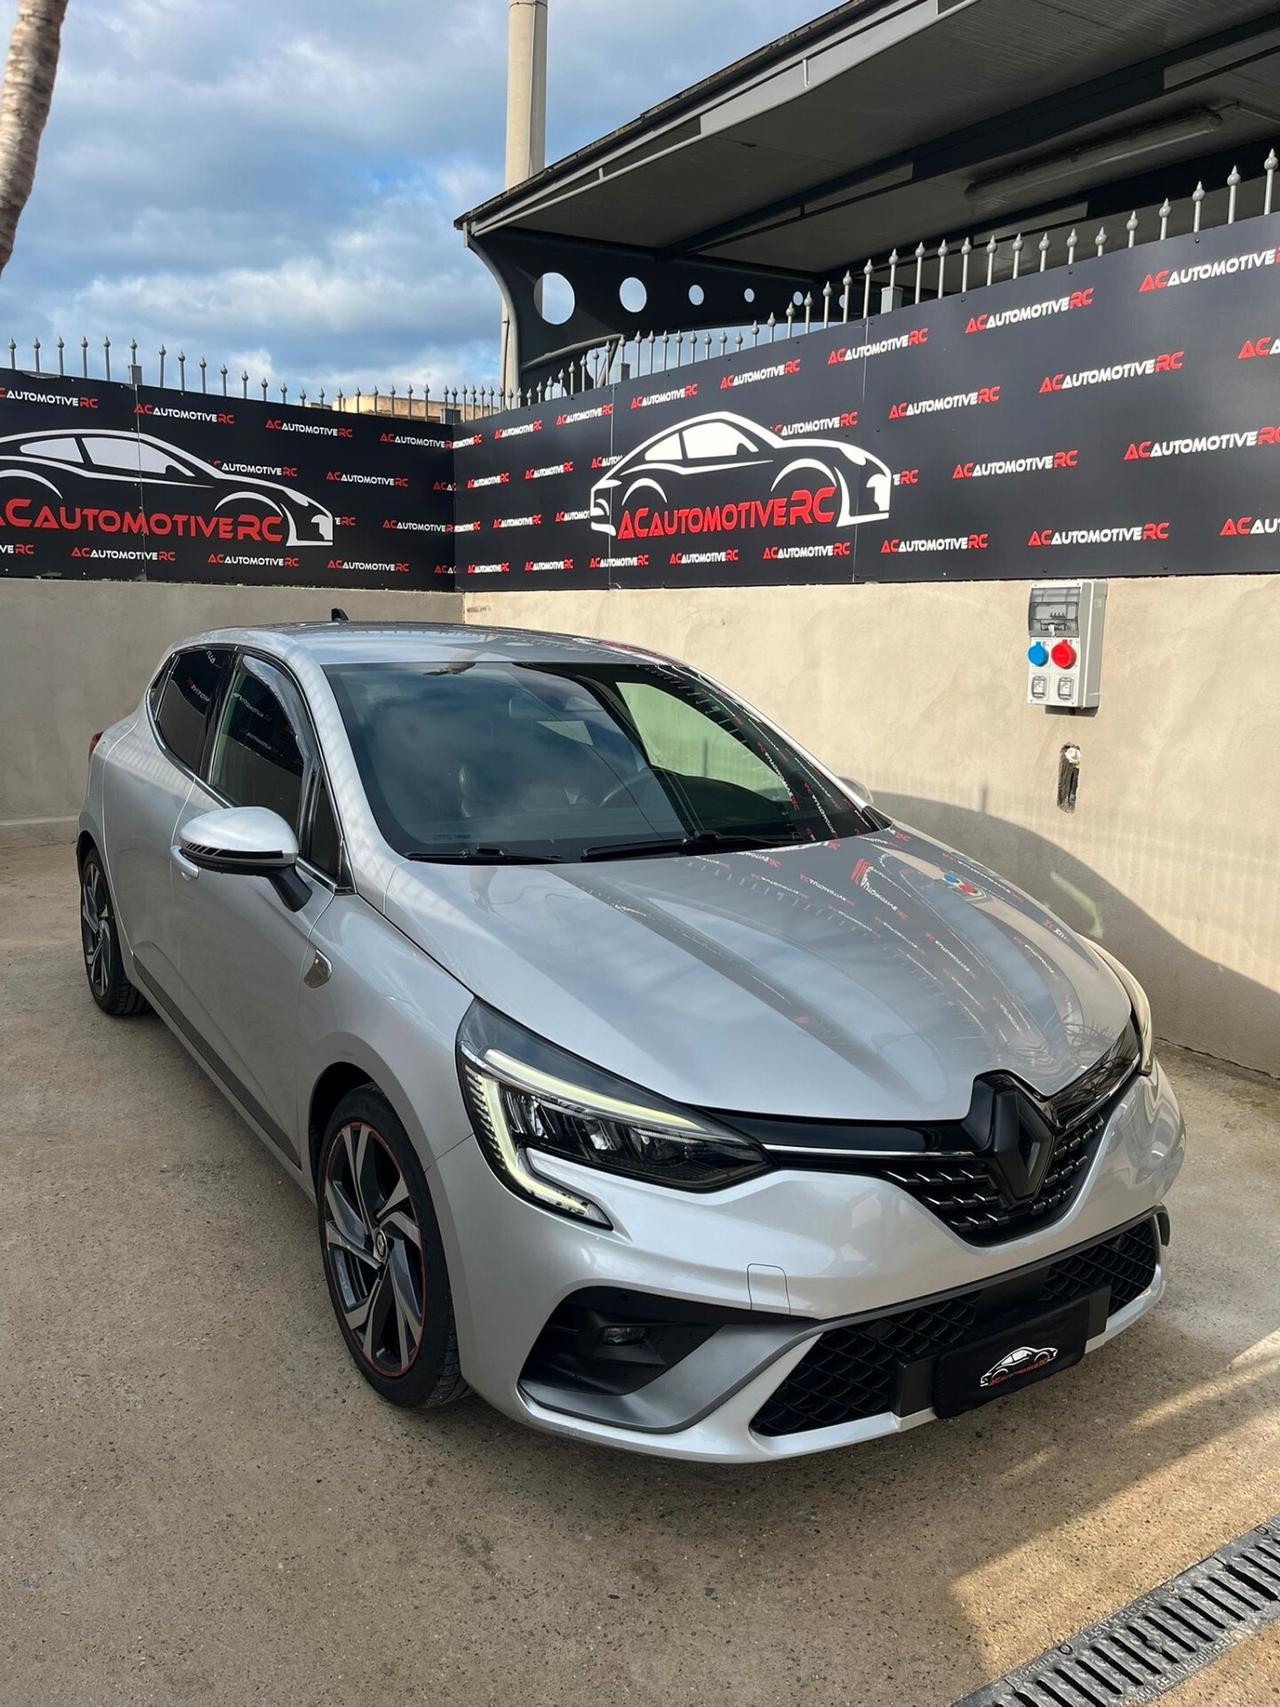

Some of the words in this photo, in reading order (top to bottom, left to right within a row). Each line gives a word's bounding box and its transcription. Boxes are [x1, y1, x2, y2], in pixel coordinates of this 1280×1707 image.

[1138, 245, 1280, 293] ACAUTOMOTIVE
[964, 286, 1095, 334] ACAUTOMOTIVERC
[826, 327, 929, 366] ACAUTOMOTIVERC
[719, 358, 802, 390] ACAUTOMOTIVERC
[1039, 350, 1185, 394] ACAUTOMOTIVERC
[630, 383, 698, 410] ACAUTOMOTIVERC
[888, 385, 1001, 420] ACAUTOMOTIVERC
[133, 402, 236, 425] ACAUTOMOTIVERC
[555, 403, 614, 426] ACAUTOMOTIVERC
[265, 419, 353, 438] ACAUTOMOTIVERC
[524, 461, 574, 480] ACAUTOMOTIVERC
[952, 449, 1079, 480] ACAUTOMOTIVERC
[326, 471, 409, 487] ACAUTOMOTIVERC
[0, 497, 283, 543] CAUTOMOTIVERC
[492, 514, 542, 529] ACAUTOMOTIVERC
[617, 486, 837, 540] ACAUTOMOTIVERC
[880, 533, 989, 554] ACAUTOMOTIVERC
[1027, 522, 1170, 547] ACAUTOMOTIVERC
[71, 547, 176, 561] ACAUTOMOTIVERC
[207, 553, 300, 567] ACAUTOMOTIVERC
[589, 553, 649, 569] ACAUTOMOTIVERC
[669, 549, 739, 565] ACAUTOMOTIVERC
[762, 541, 851, 560] ACAUTOMOTIVERC
[327, 559, 409, 572] ACAUTOMOTIVERC
[524, 558, 574, 572] ACAUTOMOTIVERC
